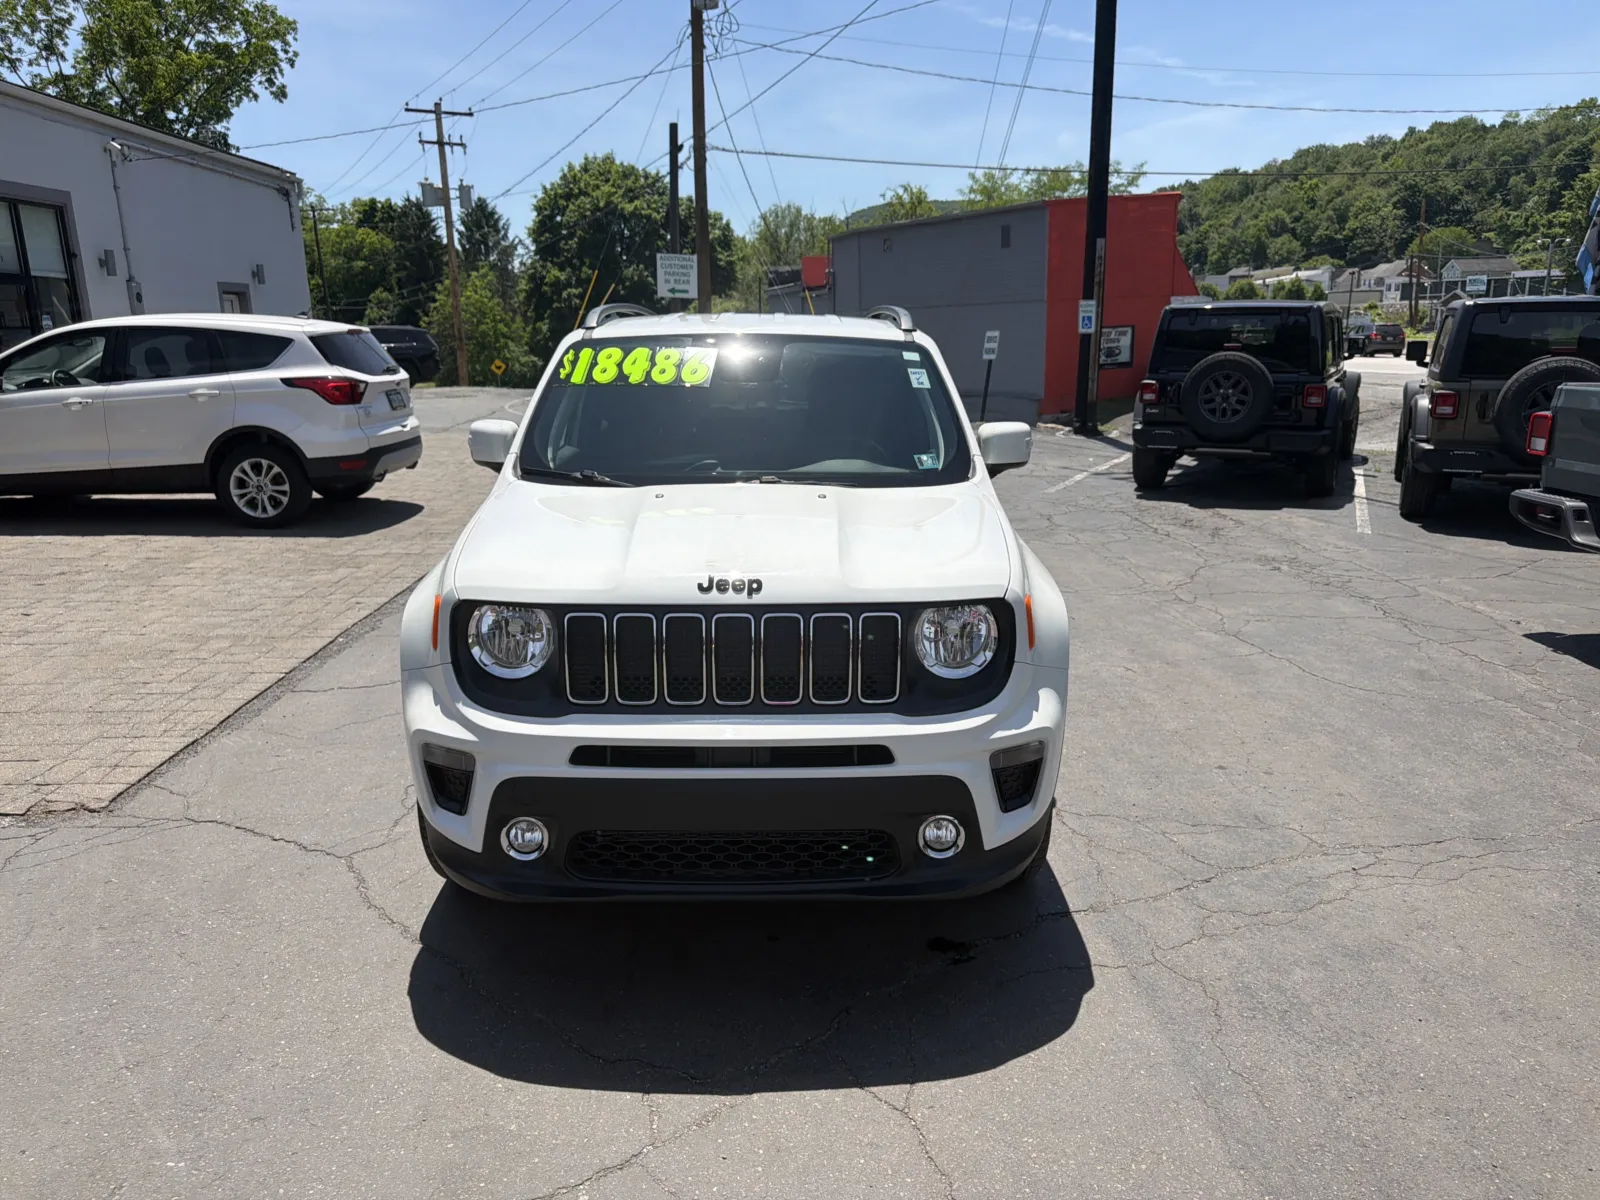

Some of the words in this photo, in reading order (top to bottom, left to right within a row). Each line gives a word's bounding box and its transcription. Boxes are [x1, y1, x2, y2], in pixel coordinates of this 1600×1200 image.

[663, 270, 690, 278] PARKING
[559, 346, 711, 385] $18486
[697, 574, 763, 600] Jeep
